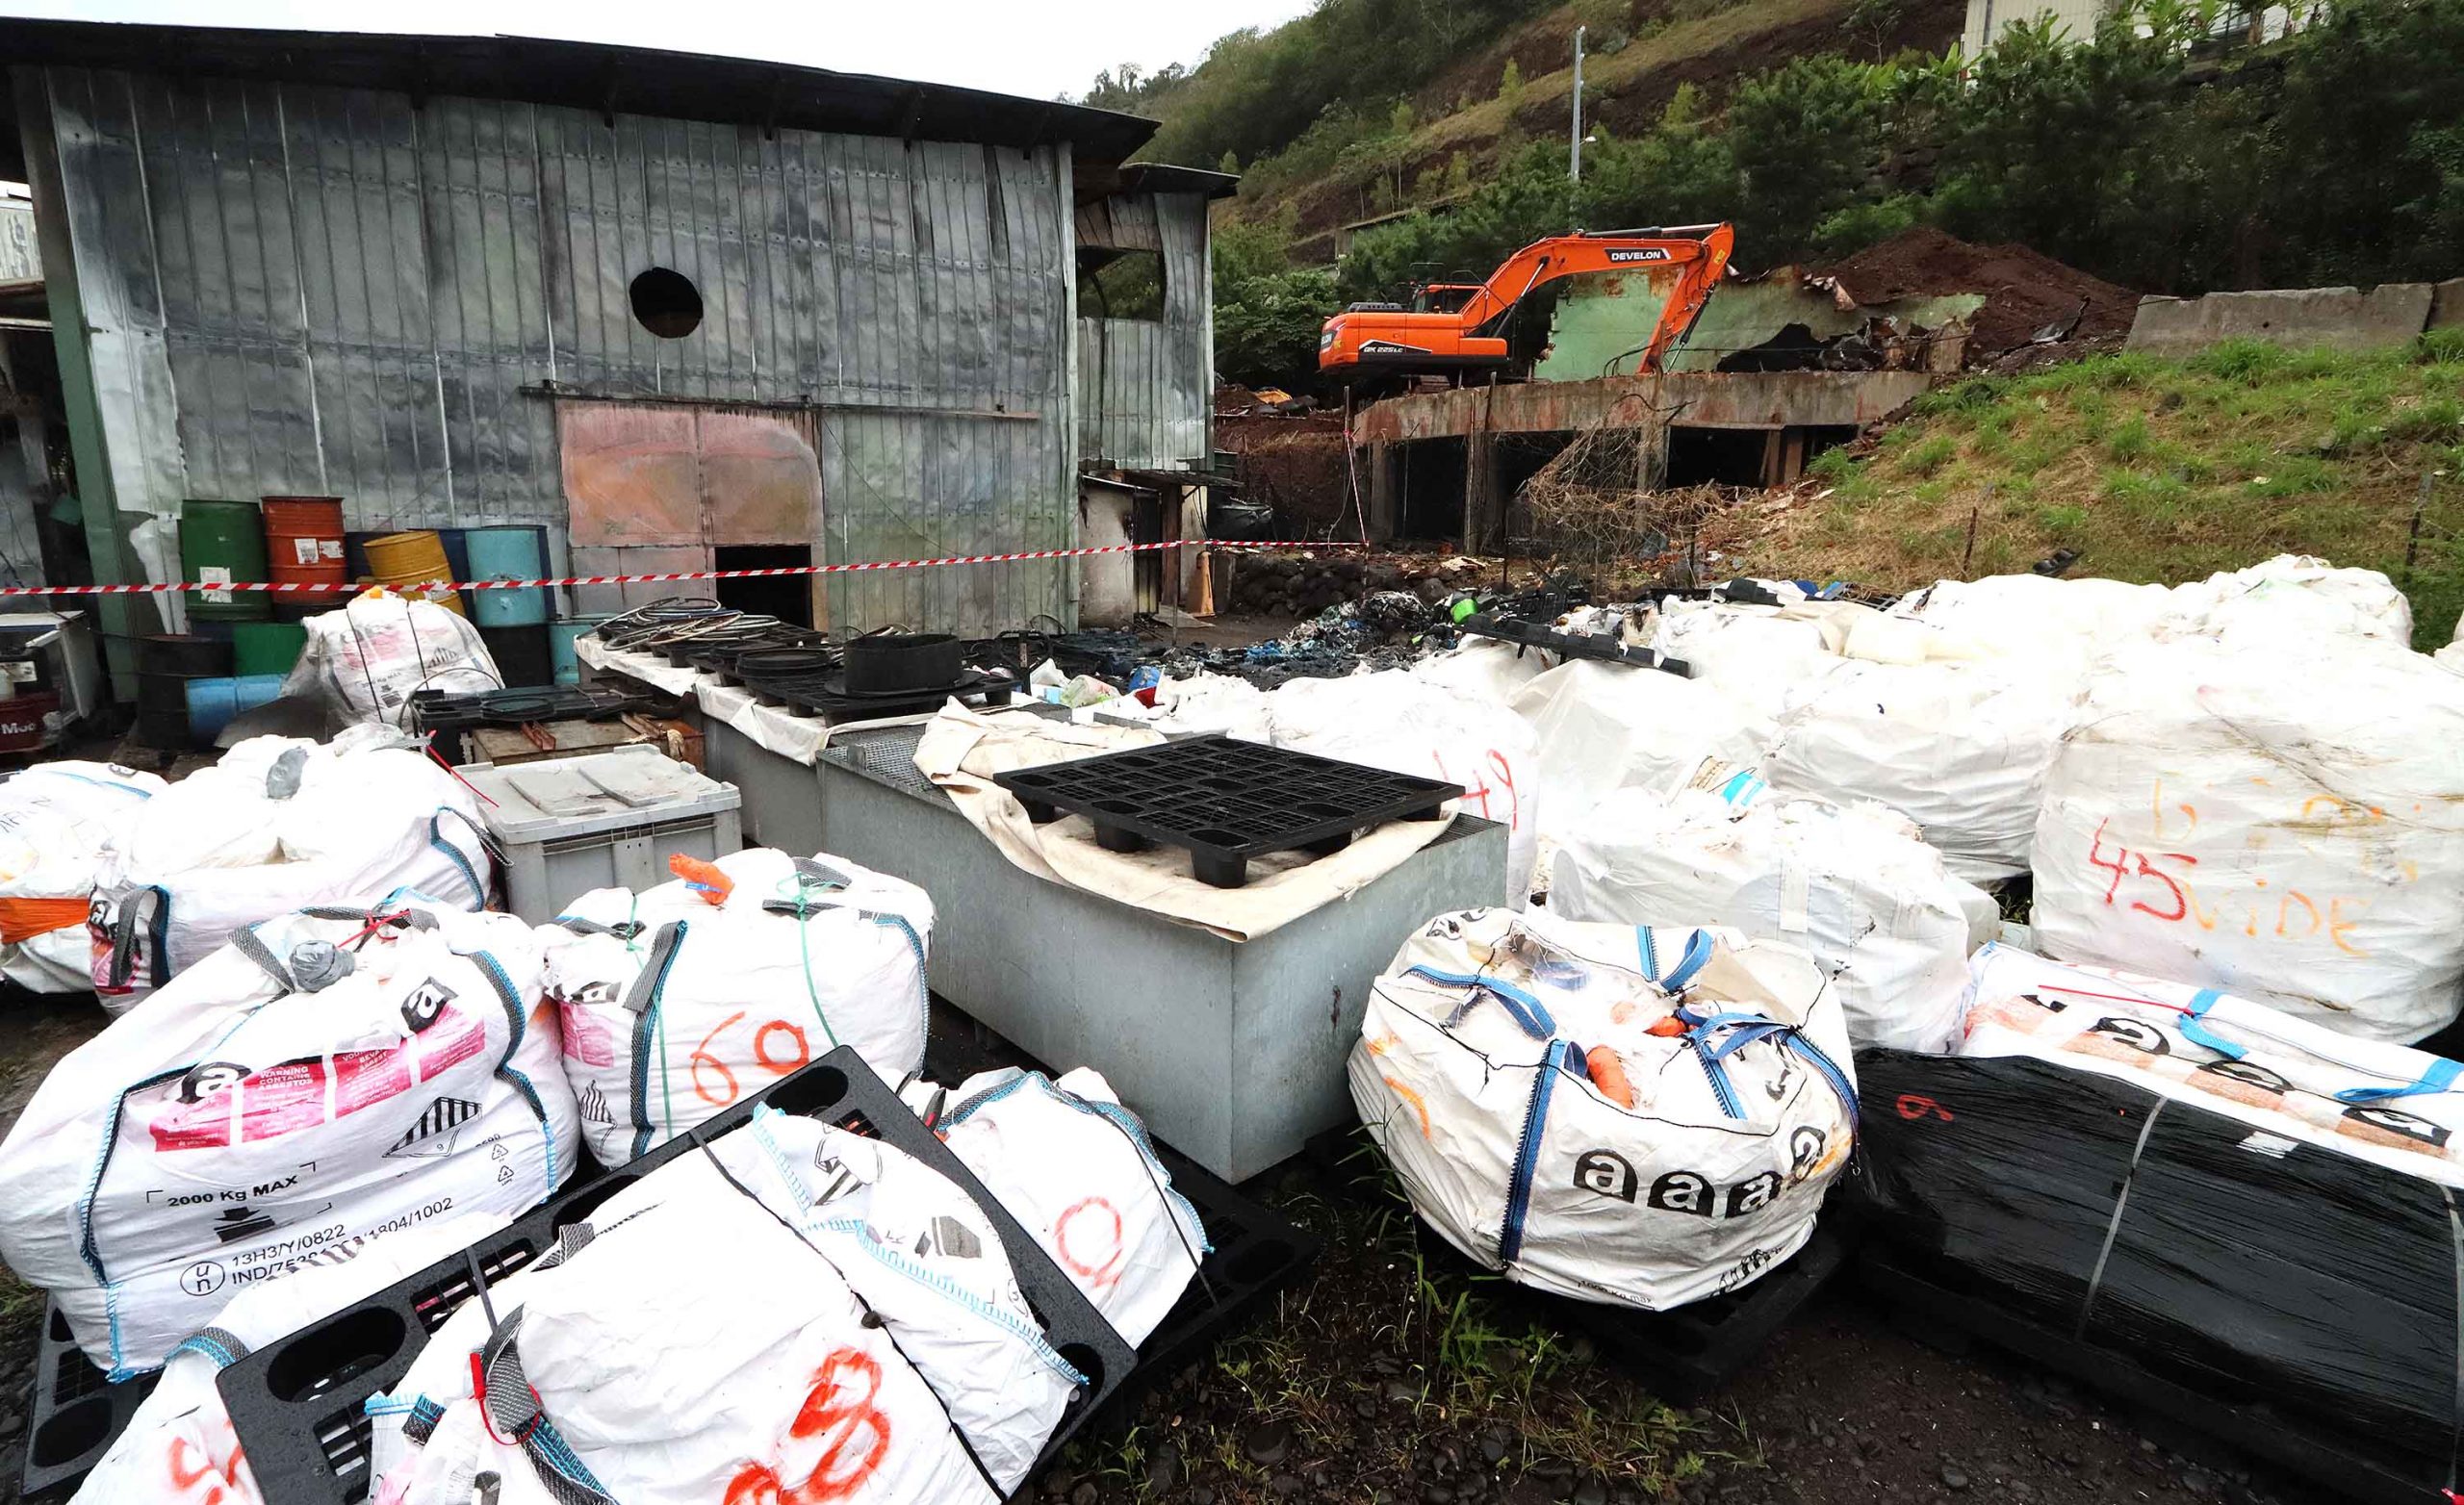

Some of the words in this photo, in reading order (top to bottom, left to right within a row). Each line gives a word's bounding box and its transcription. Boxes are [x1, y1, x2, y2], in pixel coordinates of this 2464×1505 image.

[1611, 251, 1661, 261] DEVELON
[2089, 817, 2197, 922] 45
[260, 1066, 309, 1079] WARNING
[690, 1010, 810, 1108] 60
[167, 1193, 214, 1207] 2000
[220, 1189, 247, 1202] Kg
[252, 1175, 298, 1197] MAX
[232, 1224, 346, 1267] 13H3/Y/0822
